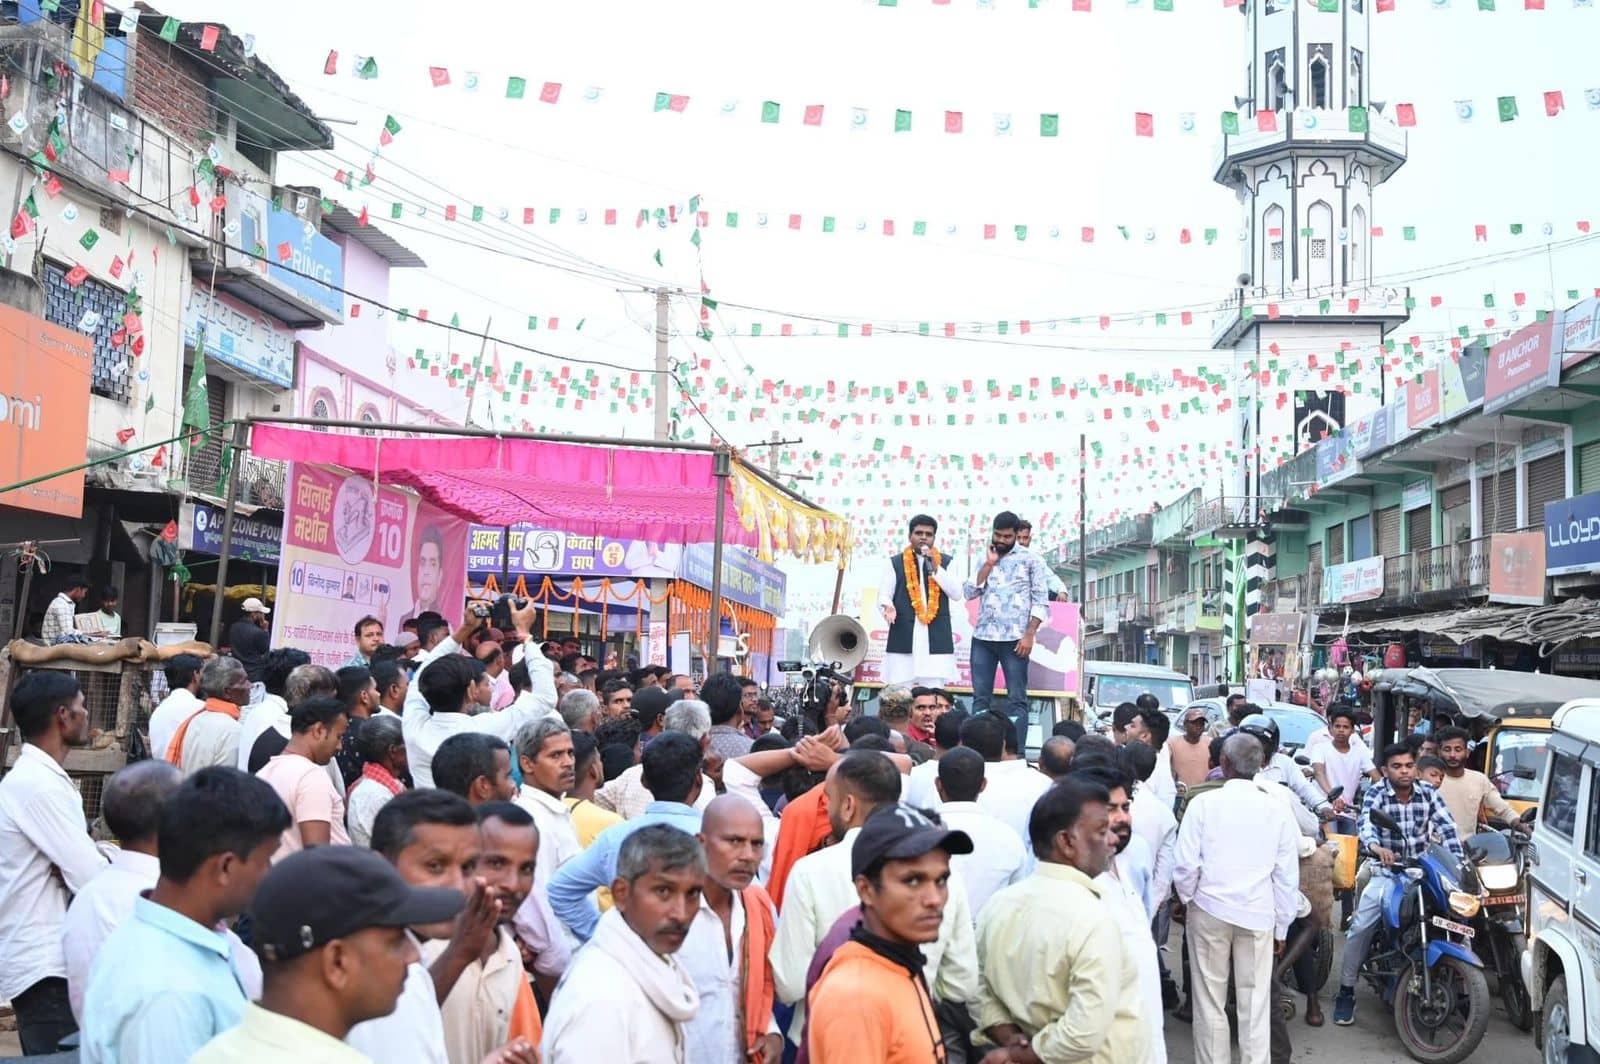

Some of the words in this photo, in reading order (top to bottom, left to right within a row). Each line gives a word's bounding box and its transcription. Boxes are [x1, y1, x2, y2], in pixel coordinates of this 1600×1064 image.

[280, 248, 332, 285] RINCE
[1504, 334, 1540, 366] ANCHOR
[296, 474, 333, 515] सिलाई
[231, 518, 260, 536] ZONE
[260, 524, 284, 541] POU
[294, 511, 330, 545] मशीन
[379, 522, 402, 561] 10
[470, 529, 501, 551] अहमद
[1548, 516, 1600, 548] LLOYD
[467, 554, 496, 569] चुनाव
[571, 555, 595, 570] छाप
[608, 552, 618, 566] 5
[292, 567, 304, 586] 10
